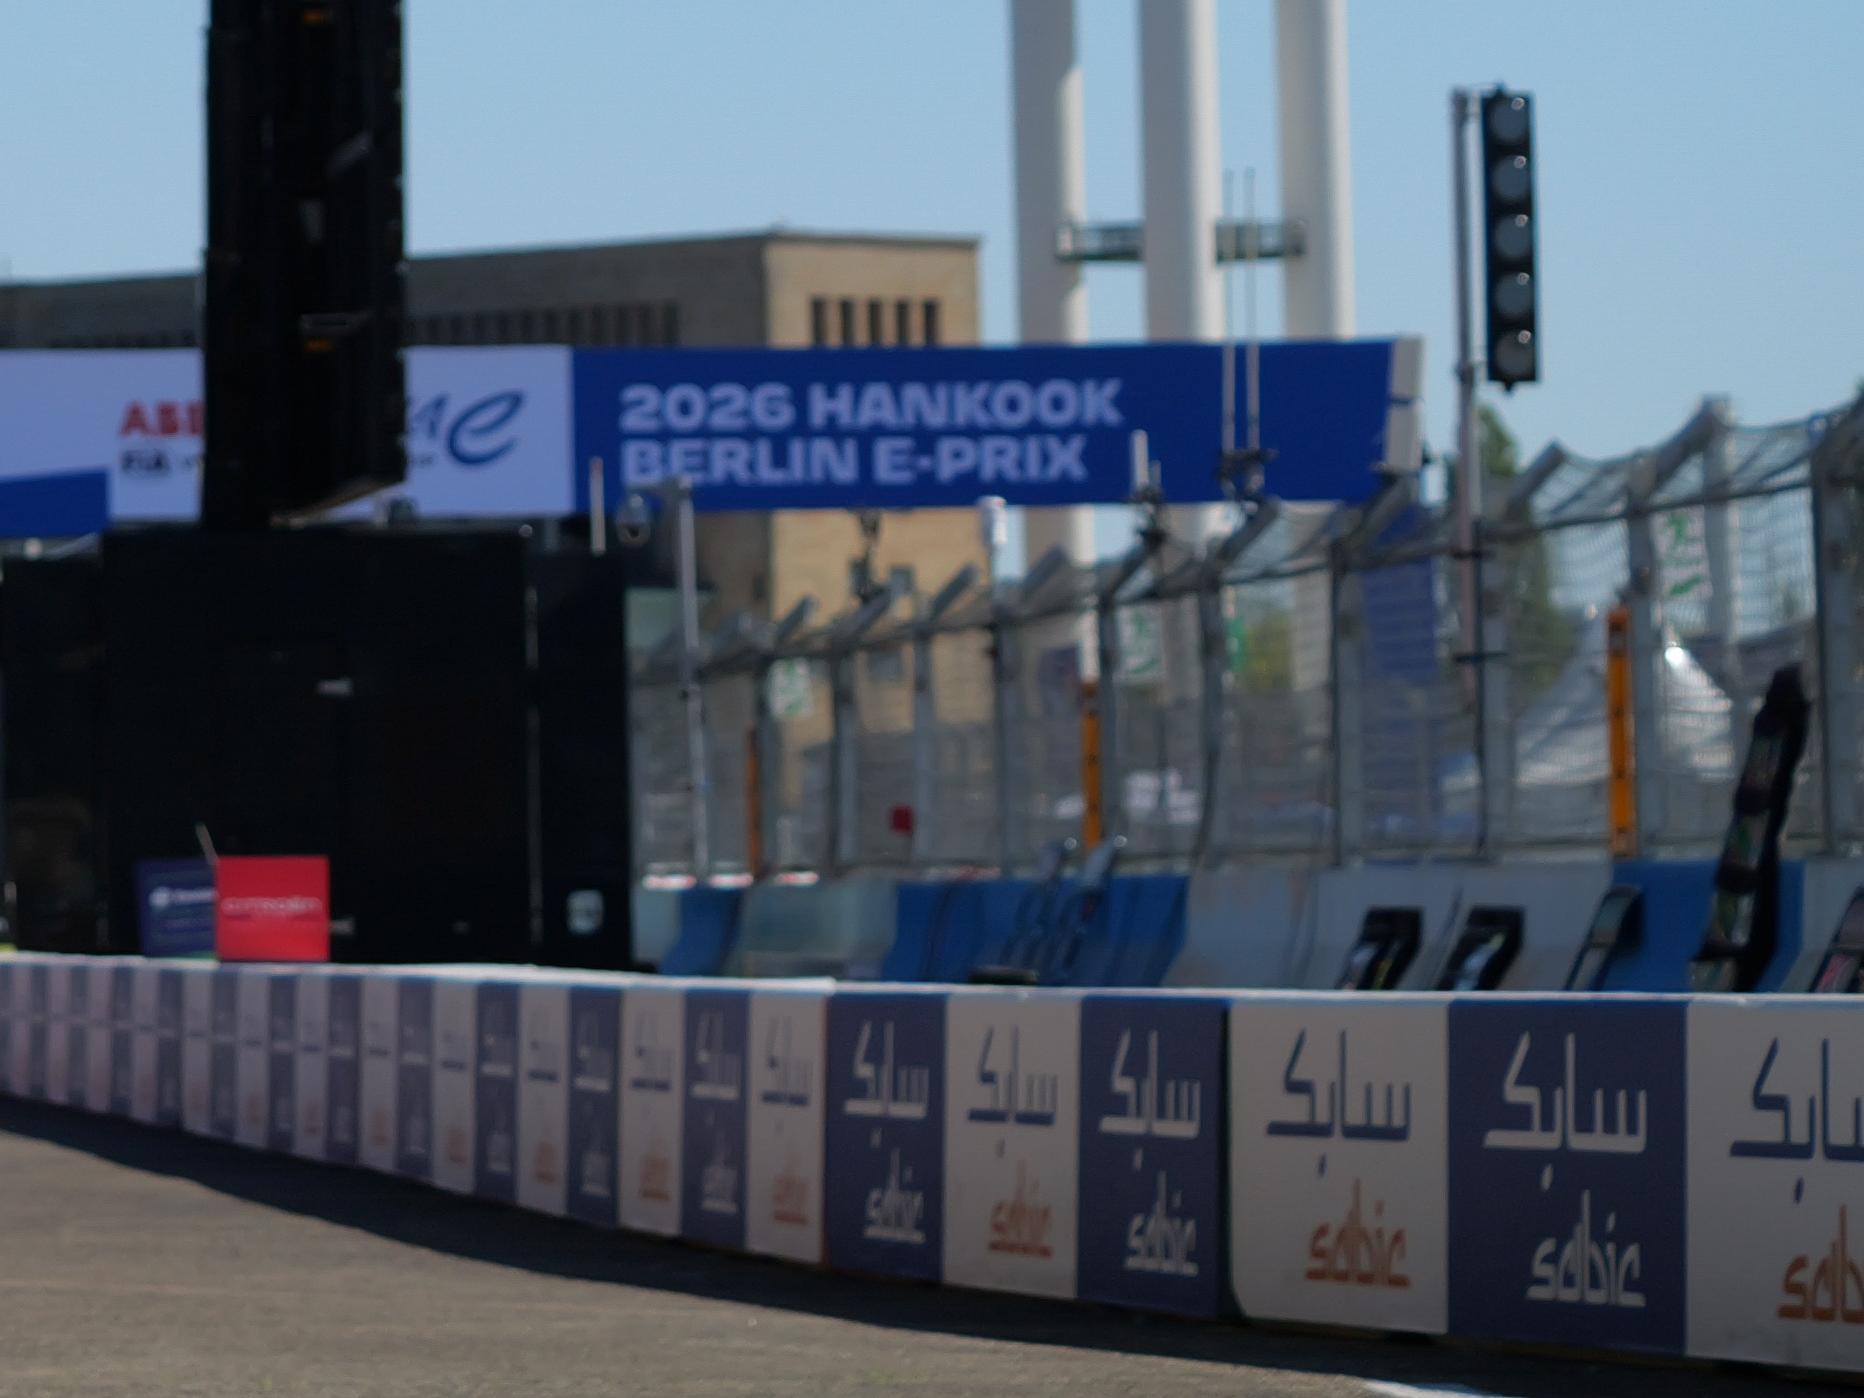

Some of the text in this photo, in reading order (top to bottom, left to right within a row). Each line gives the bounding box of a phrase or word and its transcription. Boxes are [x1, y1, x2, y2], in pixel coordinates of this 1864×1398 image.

[618, 377, 1125, 433] 2026 HANKOOK
[619, 434, 1091, 486] BERLIN E-PRIX
[1525, 1189, 1647, 1307] sabic
[1777, 1203, 1864, 1324] sab
